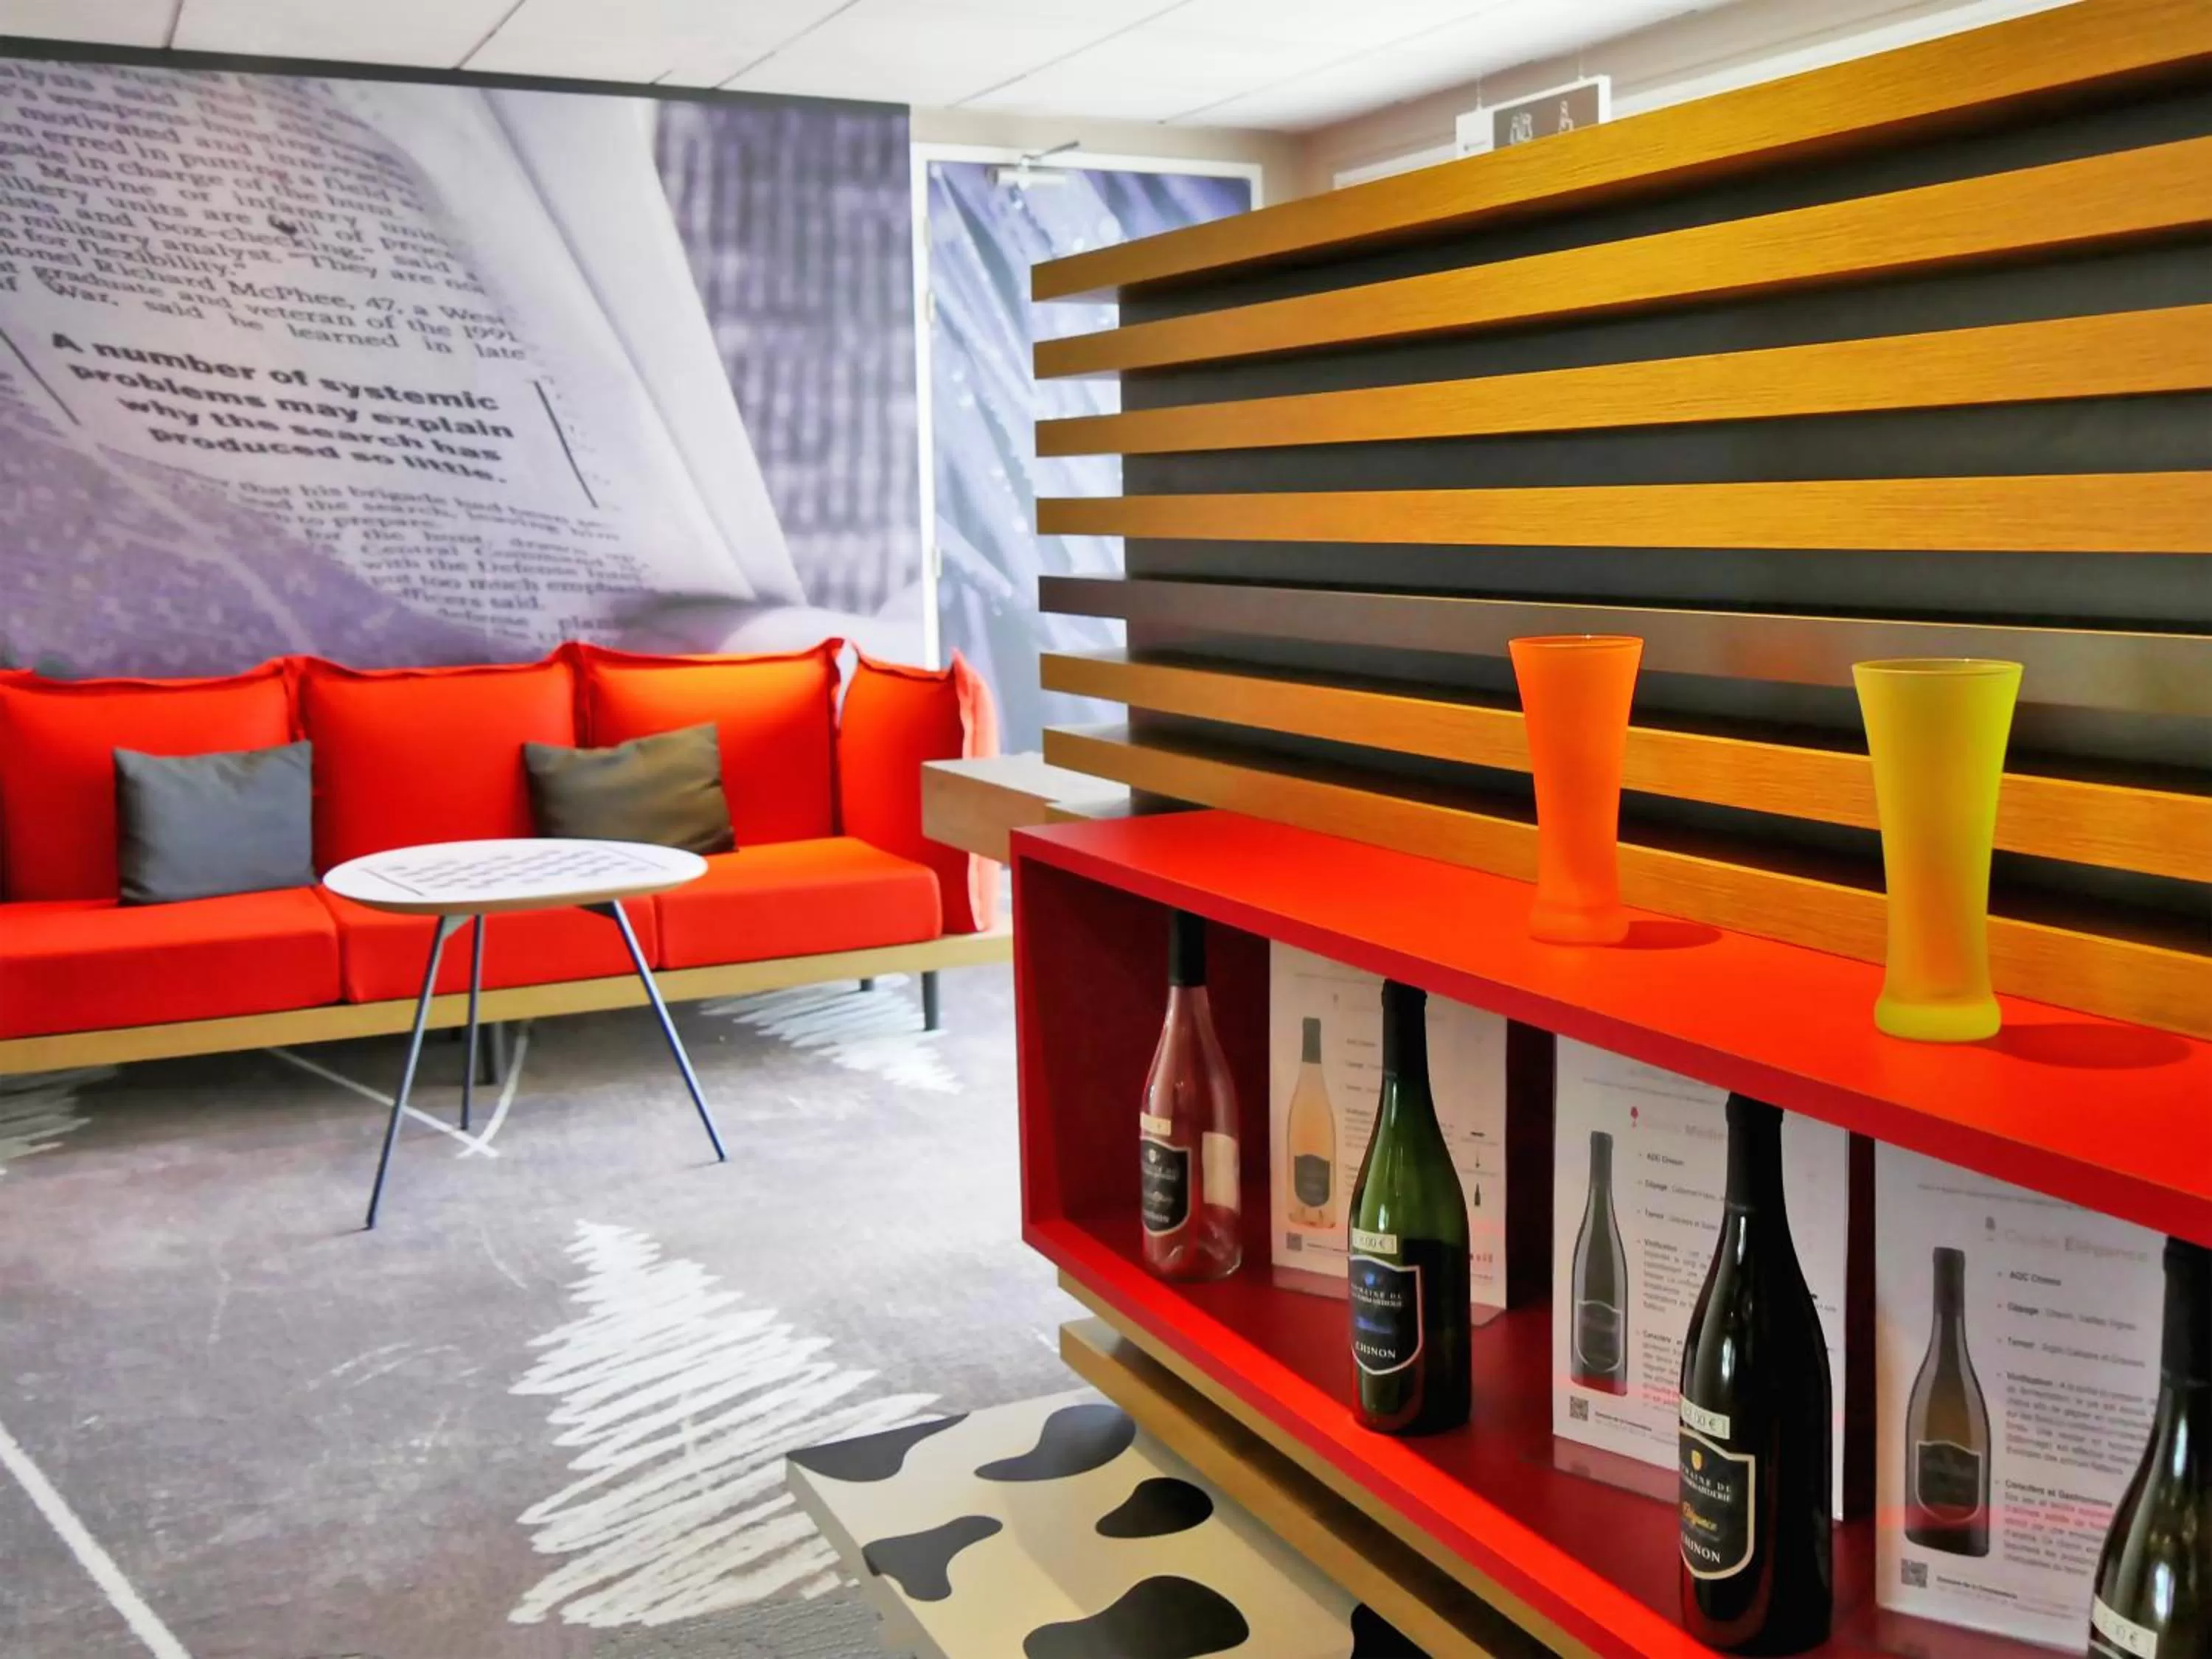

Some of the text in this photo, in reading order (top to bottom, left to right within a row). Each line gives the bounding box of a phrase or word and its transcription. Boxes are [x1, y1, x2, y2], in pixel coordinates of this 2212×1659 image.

[17, 106, 181, 145] motivated
[195, 137, 254, 157] and
[36, 161, 155, 196] Marine
[178, 189, 209, 202] or
[233, 191, 358, 230] infantry
[41, 130, 129, 156] erred
[134, 142, 170, 162] in
[178, 152, 293, 187] putting
[322, 175, 391, 202] field
[74, 152, 110, 173] in
[116, 161, 223, 188] charge
[232, 177, 263, 192] of
[271, 183, 319, 203] the
[22, 227, 69, 248] for
[75, 208, 136, 228] and
[393, 254, 451, 274] said
[105, 196, 189, 218] units
[203, 209, 251, 224] are
[335, 227, 364, 243] of
[92, 258, 217, 292] Richard
[225, 278, 357, 311] McPhee,
[390, 270, 435, 285] are
[143, 300, 205, 320] said
[227, 312, 263, 330] he
[286, 322, 400, 349] learned
[423, 337, 453, 354] in
[474, 343, 525, 360] late
[178, 291, 233, 310] and
[246, 305, 355, 327] veteran
[366, 314, 394, 330] of
[406, 318, 451, 336] the
[52, 333, 498, 411] A number of systemic
[69, 364, 267, 408] problems
[276, 399, 358, 423] may
[371, 413, 514, 438] explain
[119, 399, 501, 462] why the search has
[148, 421, 505, 483] produced so little.
